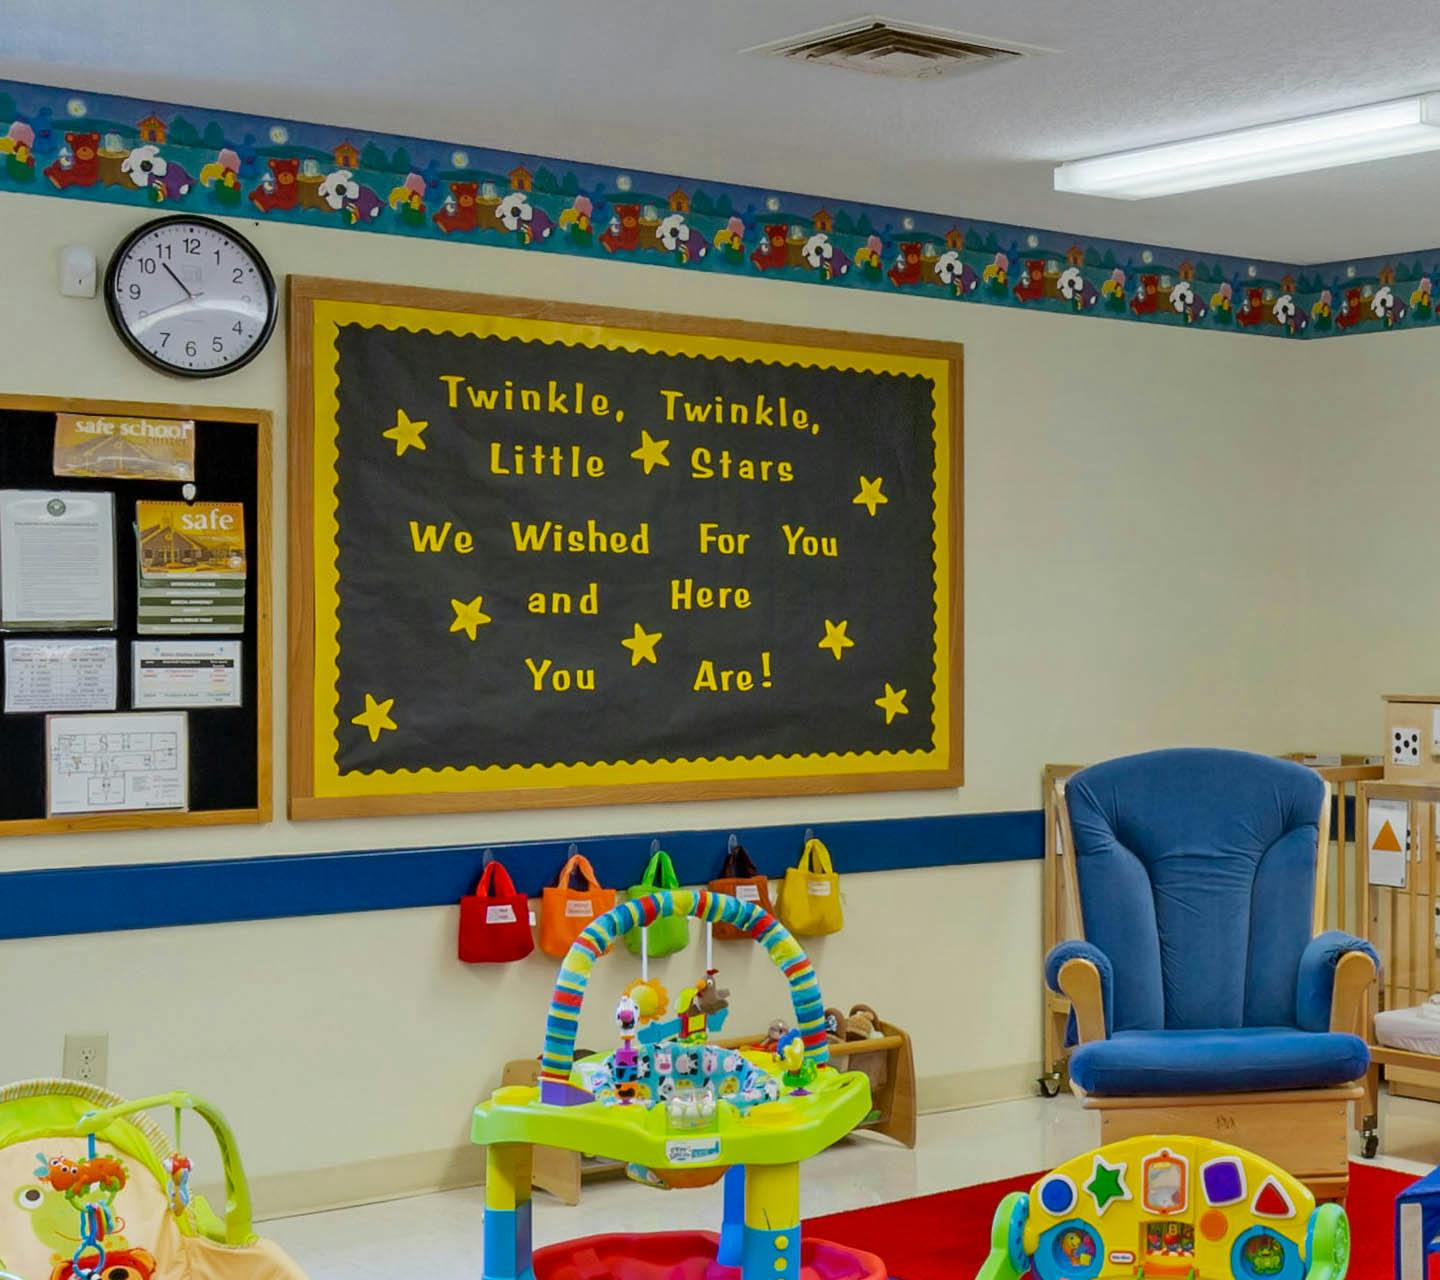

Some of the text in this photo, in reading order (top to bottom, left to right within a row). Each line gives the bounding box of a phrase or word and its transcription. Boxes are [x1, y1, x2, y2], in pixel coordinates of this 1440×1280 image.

[157, 244, 172, 260] 11
[182, 238, 201, 255] 12
[213, 249, 221, 265] 1
[138, 258, 156, 274] 10
[232, 268, 244, 284] 2
[129, 284, 141, 300] 9
[232, 320, 243, 336] 4
[160, 332, 171, 348] 7
[212, 337, 223, 352] 5
[186, 341, 197, 356] 6
[439, 375, 821, 435] Twinkle, Twinkle,
[75, 418, 188, 438] safe school
[490, 442, 795, 482] Little Stars
[182, 508, 234, 530] safe
[409, 519, 839, 557] We Wished For You
[527, 578, 752, 615] and Here
[524, 651, 773, 692] You Are!
